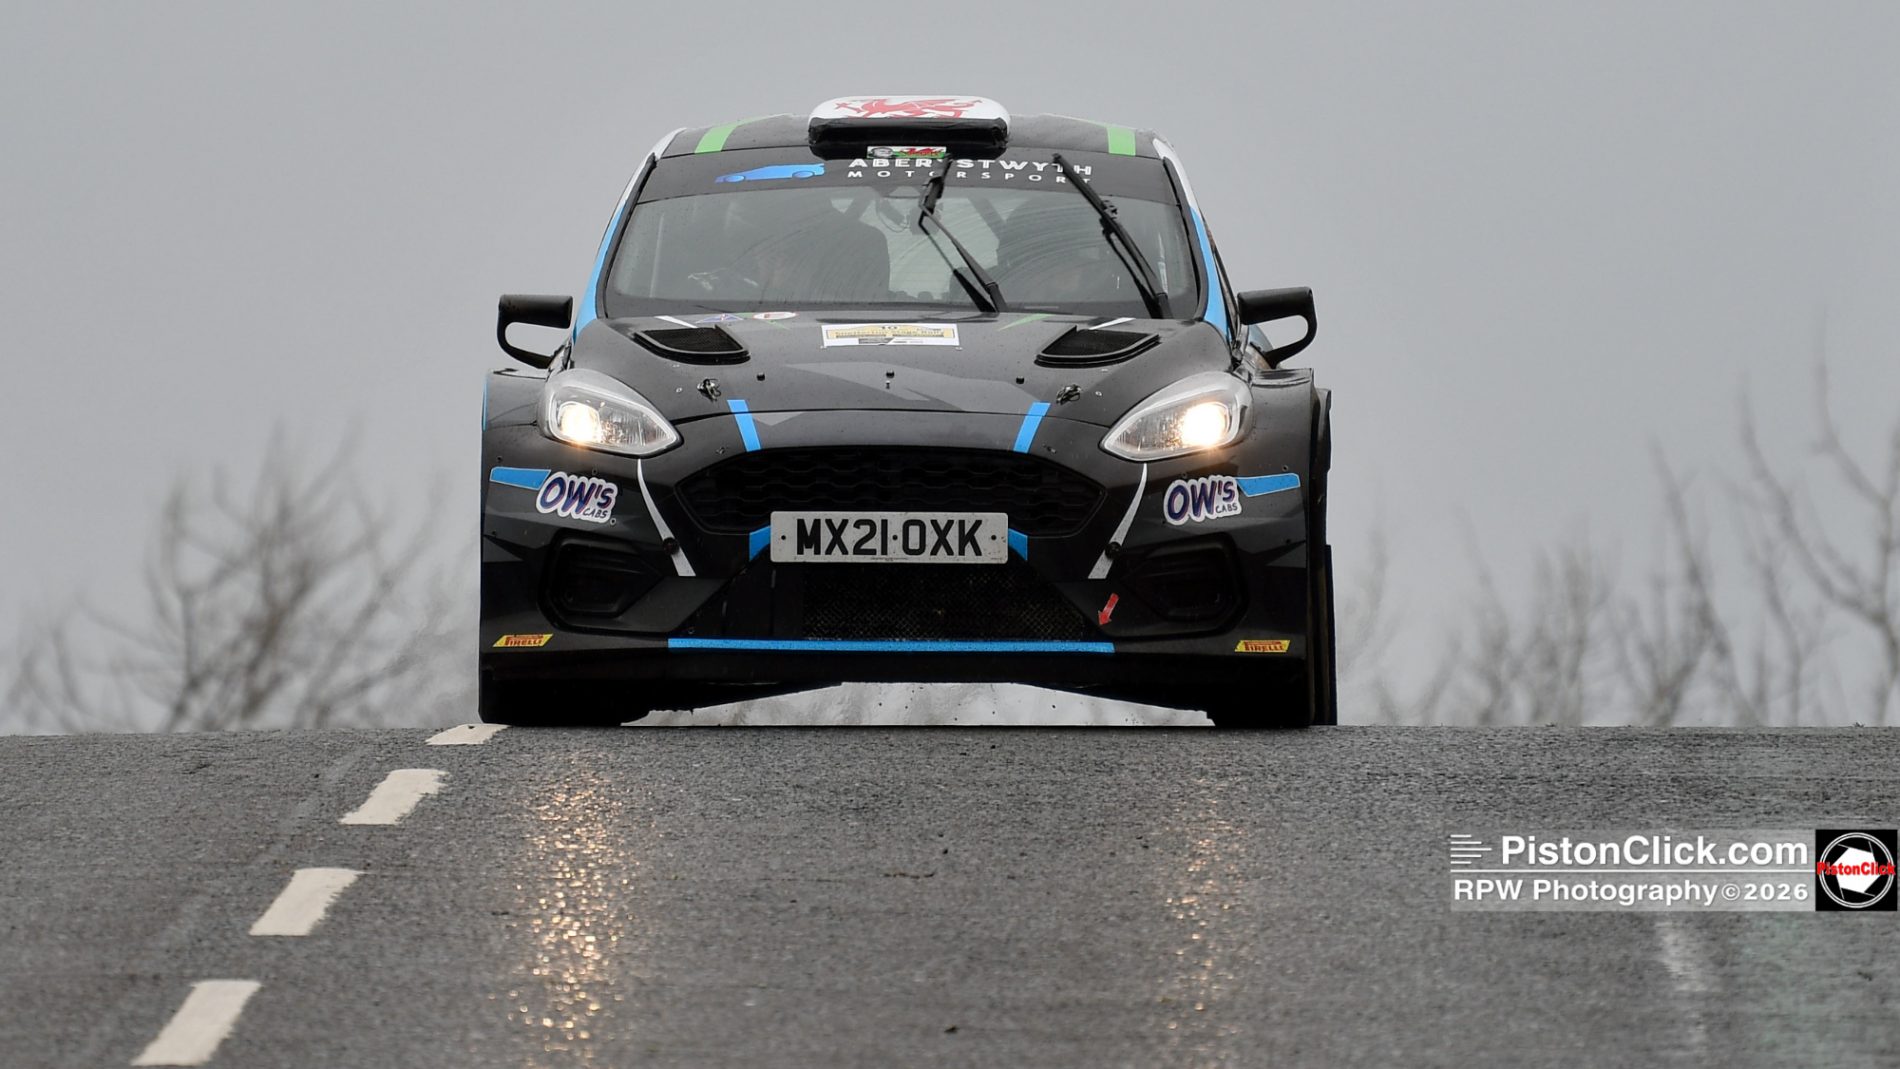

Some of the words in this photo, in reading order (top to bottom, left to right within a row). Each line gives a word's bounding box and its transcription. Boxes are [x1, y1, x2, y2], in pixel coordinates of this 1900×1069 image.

[849, 158, 1092, 175] ABERSTWYTH
[540, 476, 614, 514] OW'S
[1167, 480, 1236, 521] OW'S
[582, 507, 609, 519] CABS
[1215, 502, 1238, 513] CABS
[796, 518, 888, 556] MX21
[902, 518, 983, 556] OXK
[504, 633, 545, 647] PIRELLI
